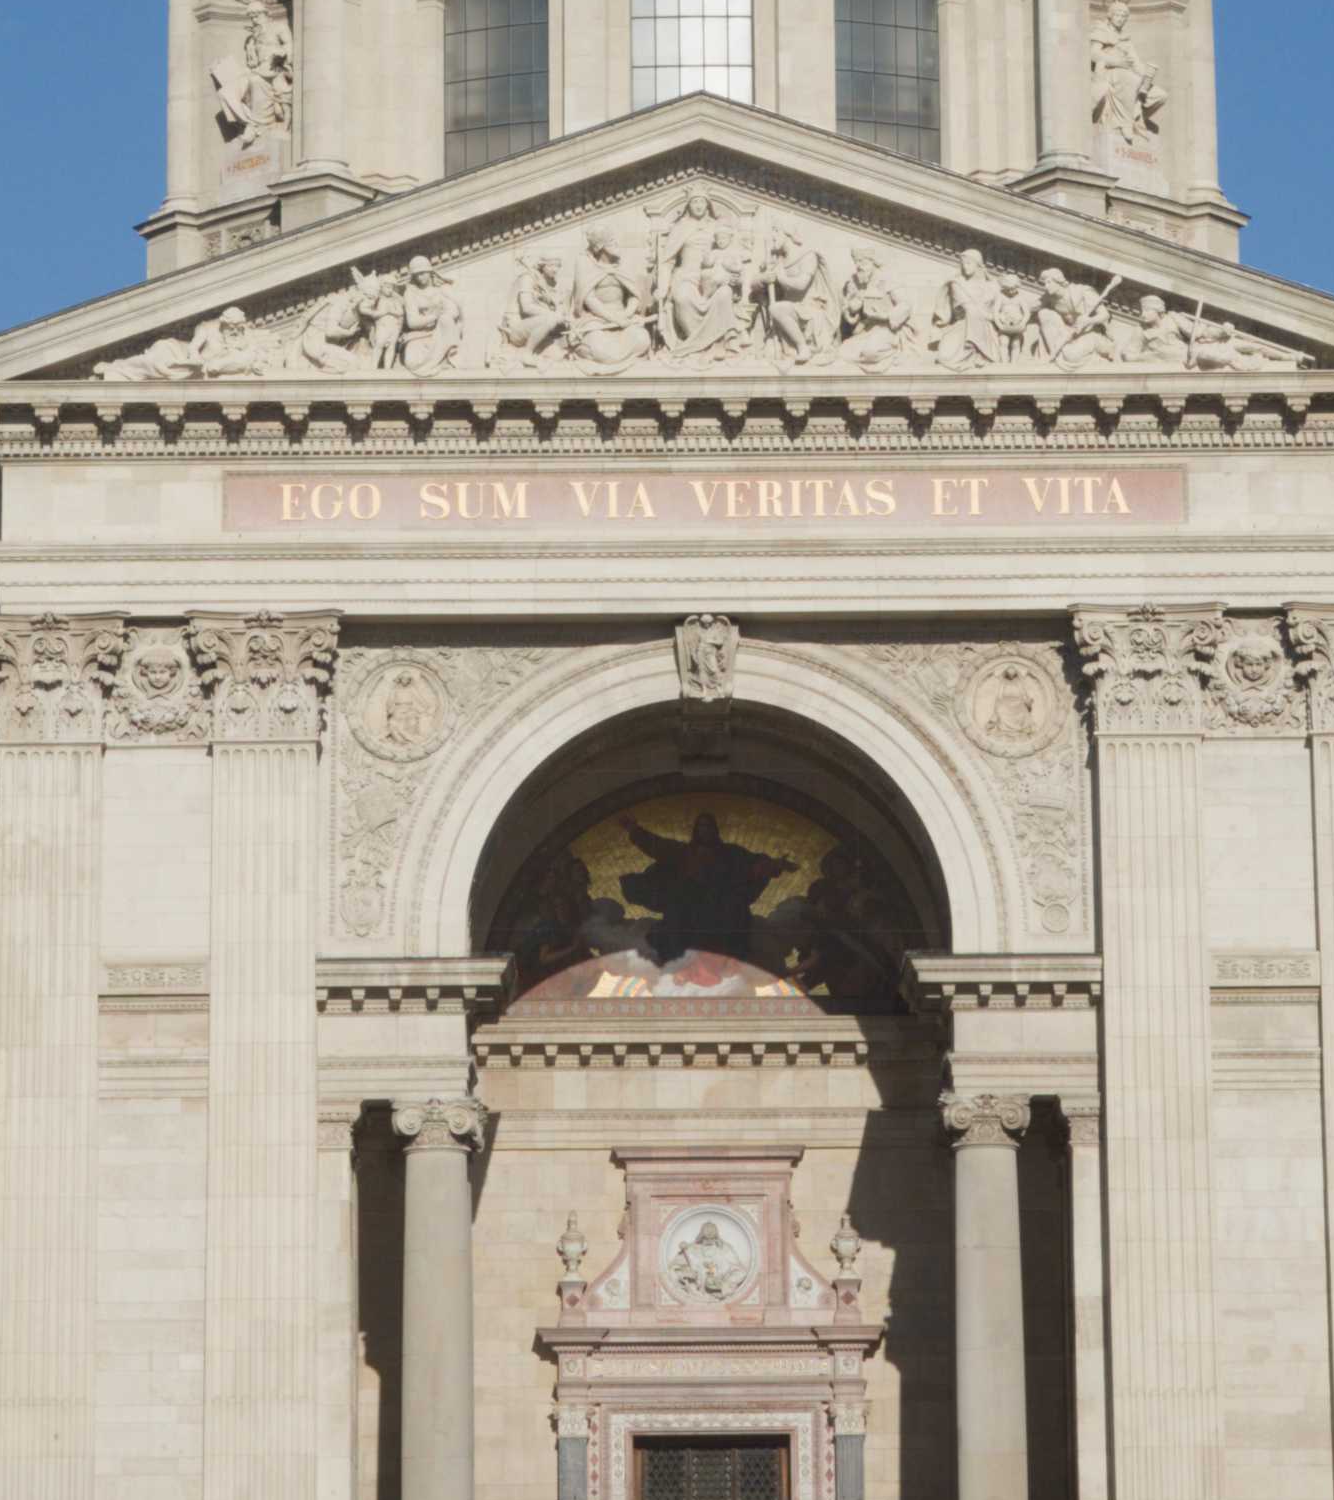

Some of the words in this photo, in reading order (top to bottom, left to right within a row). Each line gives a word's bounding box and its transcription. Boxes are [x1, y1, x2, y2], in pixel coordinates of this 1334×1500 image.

[279, 483, 381, 520] EGO
[419, 481, 531, 519] SUM
[569, 481, 657, 518] VIA
[689, 478, 897, 517] VERITAS
[930, 477, 989, 515] ET
[1022, 476, 1133, 514] VITA
